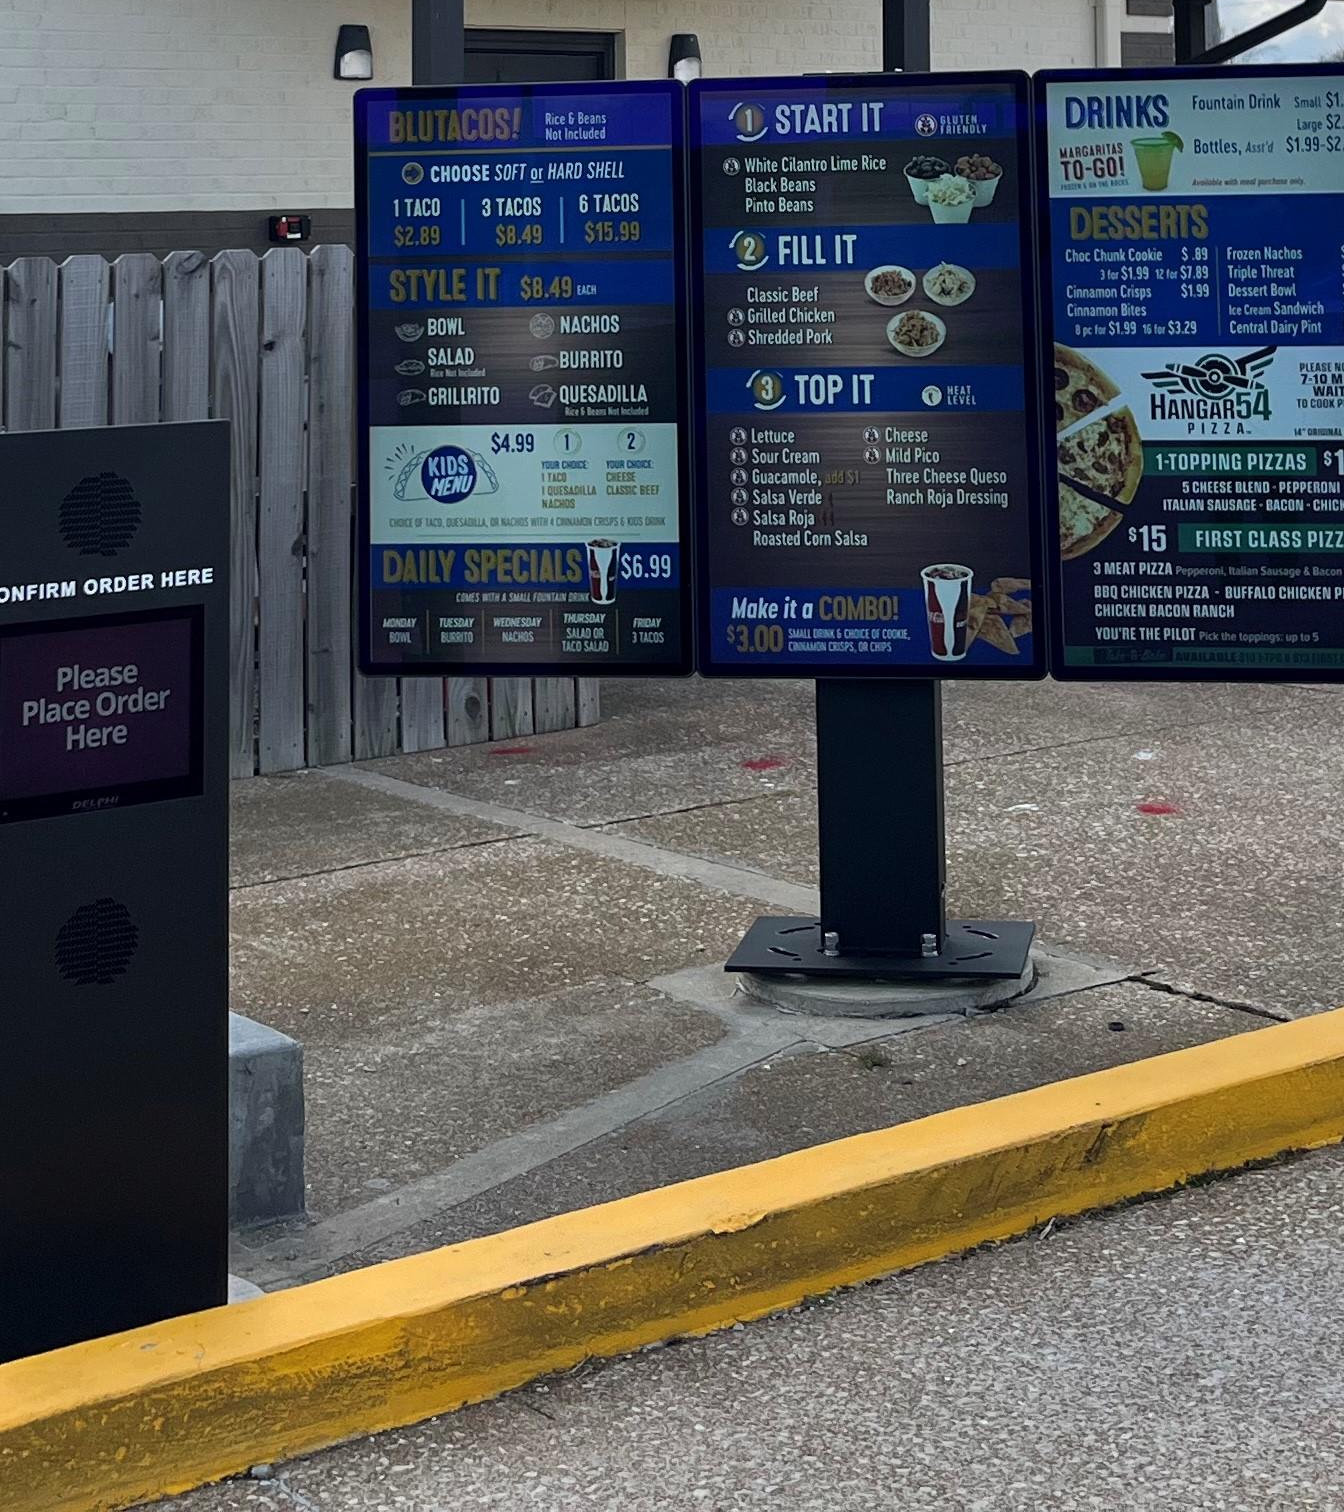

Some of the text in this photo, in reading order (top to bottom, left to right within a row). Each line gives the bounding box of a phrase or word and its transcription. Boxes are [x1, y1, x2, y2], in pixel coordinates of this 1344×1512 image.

[1192, 95, 1244, 110] Fountain
[1249, 94, 1280, 108] Drink
[1294, 96, 1321, 108] Small
[545, 113, 606, 125] Rice & Beans
[744, 110, 753, 131] 1
[775, 103, 884, 134] START IT
[940, 115, 978, 124] GLUTEN
[1065, 95, 1169, 130] DRINKS
[389, 108, 522, 143] BLUTACOS!
[545, 127, 606, 140] Not Included
[940, 124, 987, 135] FRIENDLY
[1297, 118, 1322, 132] Large
[1060, 143, 1123, 160] MARGARITAS
[1194, 139, 1241, 155] Bottles,
[431, 162, 624, 182] CHOOSE SOFT or HARD SHELL
[745, 155, 886, 172] White Cilantro Lime Rice
[1060, 157, 1125, 181] TO-GO!
[745, 177, 816, 192] Black Beans
[393, 198, 440, 216] 1 TACO
[482, 198, 541, 216] 3 TACOS
[579, 194, 639, 213] 6 TACOS
[1070, 204, 1208, 240] DESSERTS
[394, 226, 440, 246] $2.89
[496, 225, 542, 245] $8.49
[585, 222, 640, 243] $15.99
[744, 237, 755, 260] 2
[779, 234, 856, 264] FILL IT
[1066, 248, 1162, 263] Choc Chunk Cookie
[1227, 247, 1302, 261] Frozen Nachos
[390, 267, 596, 302] STYLE IT $8.49 EACH
[1067, 284, 1209, 300] Cinnamon Crisps $1.99
[747, 287, 818, 302] Classic Beef
[747, 307, 834, 323] Grilled Chicken
[1229, 301, 1324, 316] Ice Cream Sandwich
[428, 318, 465, 335] BOWL
[560, 315, 619, 333] NACHOS
[1230, 320, 1321, 336] Central Dairy Pint
[748, 329, 832, 345] Shredded Pork
[428, 348, 474, 365] SALAD
[560, 350, 623, 368] BURRITO
[1300, 363, 1330, 373] PLEASE
[761, 376, 773, 398] 3
[1301, 374, 1328, 384] 7-10
[428, 387, 500, 405] GRILLRITO
[560, 385, 647, 404] QUESADILLA
[795, 374, 874, 405] TOP IT
[948, 386, 971, 395] HEAT
[1312, 386, 1344, 397] WAIT
[948, 395, 976, 405] LEVEL
[1297, 399, 1307, 408] TO
[1309, 399, 1334, 408] COOK
[491, 432, 534, 454] $4.99
[752, 428, 794, 443] Lettuce
[885, 428, 928, 443] Cheese
[885, 448, 939, 462] Mild Pico
[1156, 453, 1241, 471] 1-TOPPING
[1247, 453, 1306, 470] PIZZAS
[428, 455, 468, 477] KIDS
[752, 469, 822, 486] Guacamole,
[887, 468, 1007, 484] Three Cheese Queso
[431, 475, 473, 496] MENU
[887, 489, 1008, 508] Ranch Roja Dressing
[1163, 499, 1204, 511] ITALIAN
[1207, 499, 1256, 511] SAUSAGE
[1266, 499, 1303, 511] BACON
[1129, 525, 1166, 552] $15
[1196, 531, 1241, 548] FIRST
[1248, 531, 1301, 548] CLASS
[383, 547, 671, 585] DAILY SPECIALS $6.99
[1094, 563, 1172, 575] 3 MEAT PIZZA
[83, 574, 154, 595] ORDER
[161, 568, 213, 587] HERE
[732, 597, 778, 619] Make
[784, 596, 798, 619] it
[802, 601, 813, 618] a
[819, 596, 898, 620] COMBO!
[727, 624, 784, 652] $3.00
[1096, 628, 1195, 640] YOU'RE THE PILOT
[57, 664, 138, 692] Please
[22, 687, 170, 726] Place Order
[66, 724, 127, 750] Here
[72, 796, 119, 809] DELPHI
